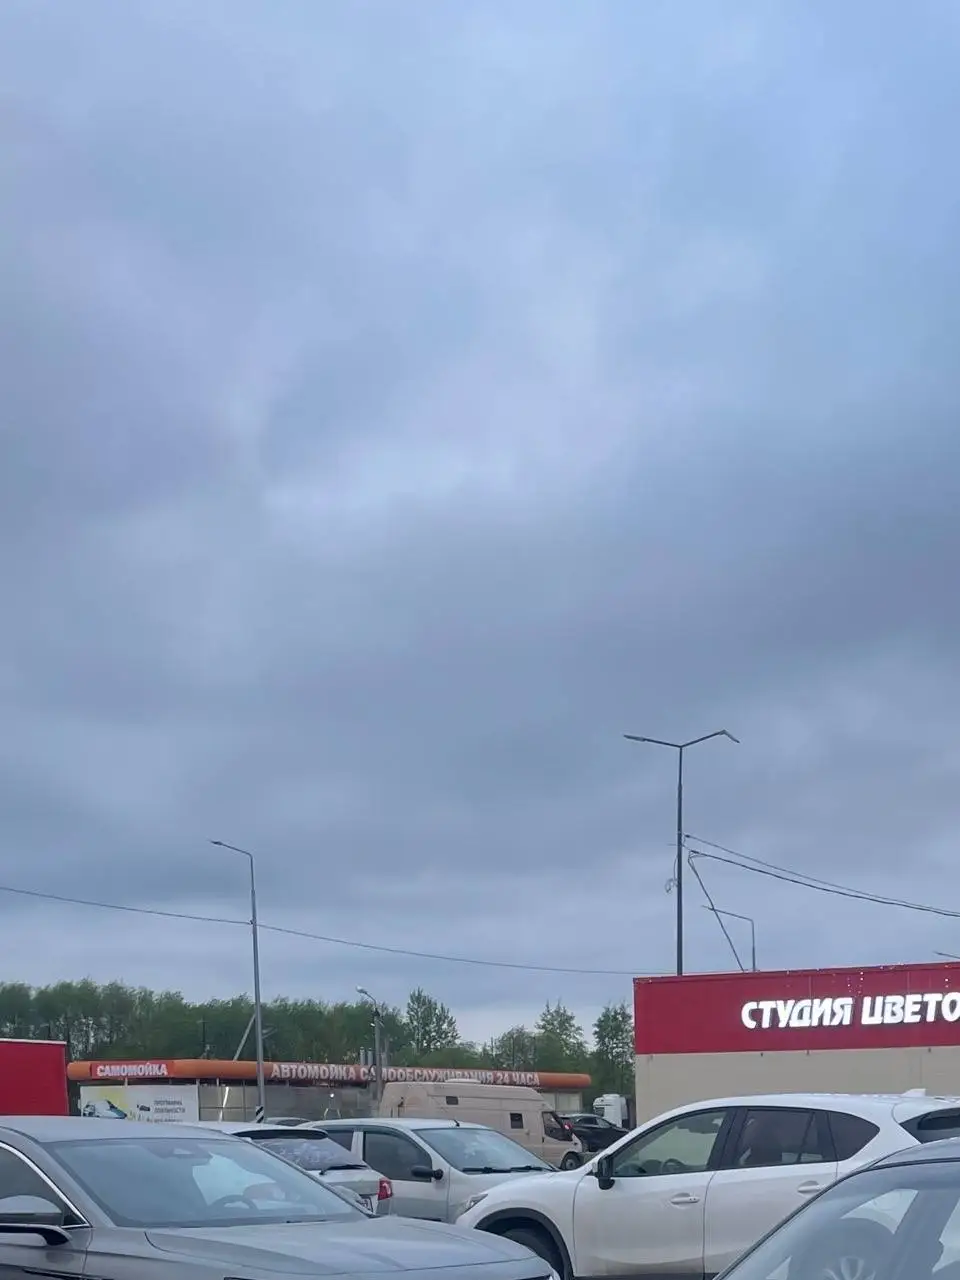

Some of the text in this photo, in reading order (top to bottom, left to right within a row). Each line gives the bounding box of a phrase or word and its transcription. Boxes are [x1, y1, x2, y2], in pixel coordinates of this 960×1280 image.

[741, 997, 853, 1028] СТУДИЯ
[96, 1062, 168, 1077] САМОМОЙКА
[271, 1063, 356, 1081] АВТОМОЙКА
[496, 1071, 510, 1085] 24
[512, 1072, 540, 1086] ЧАСА
